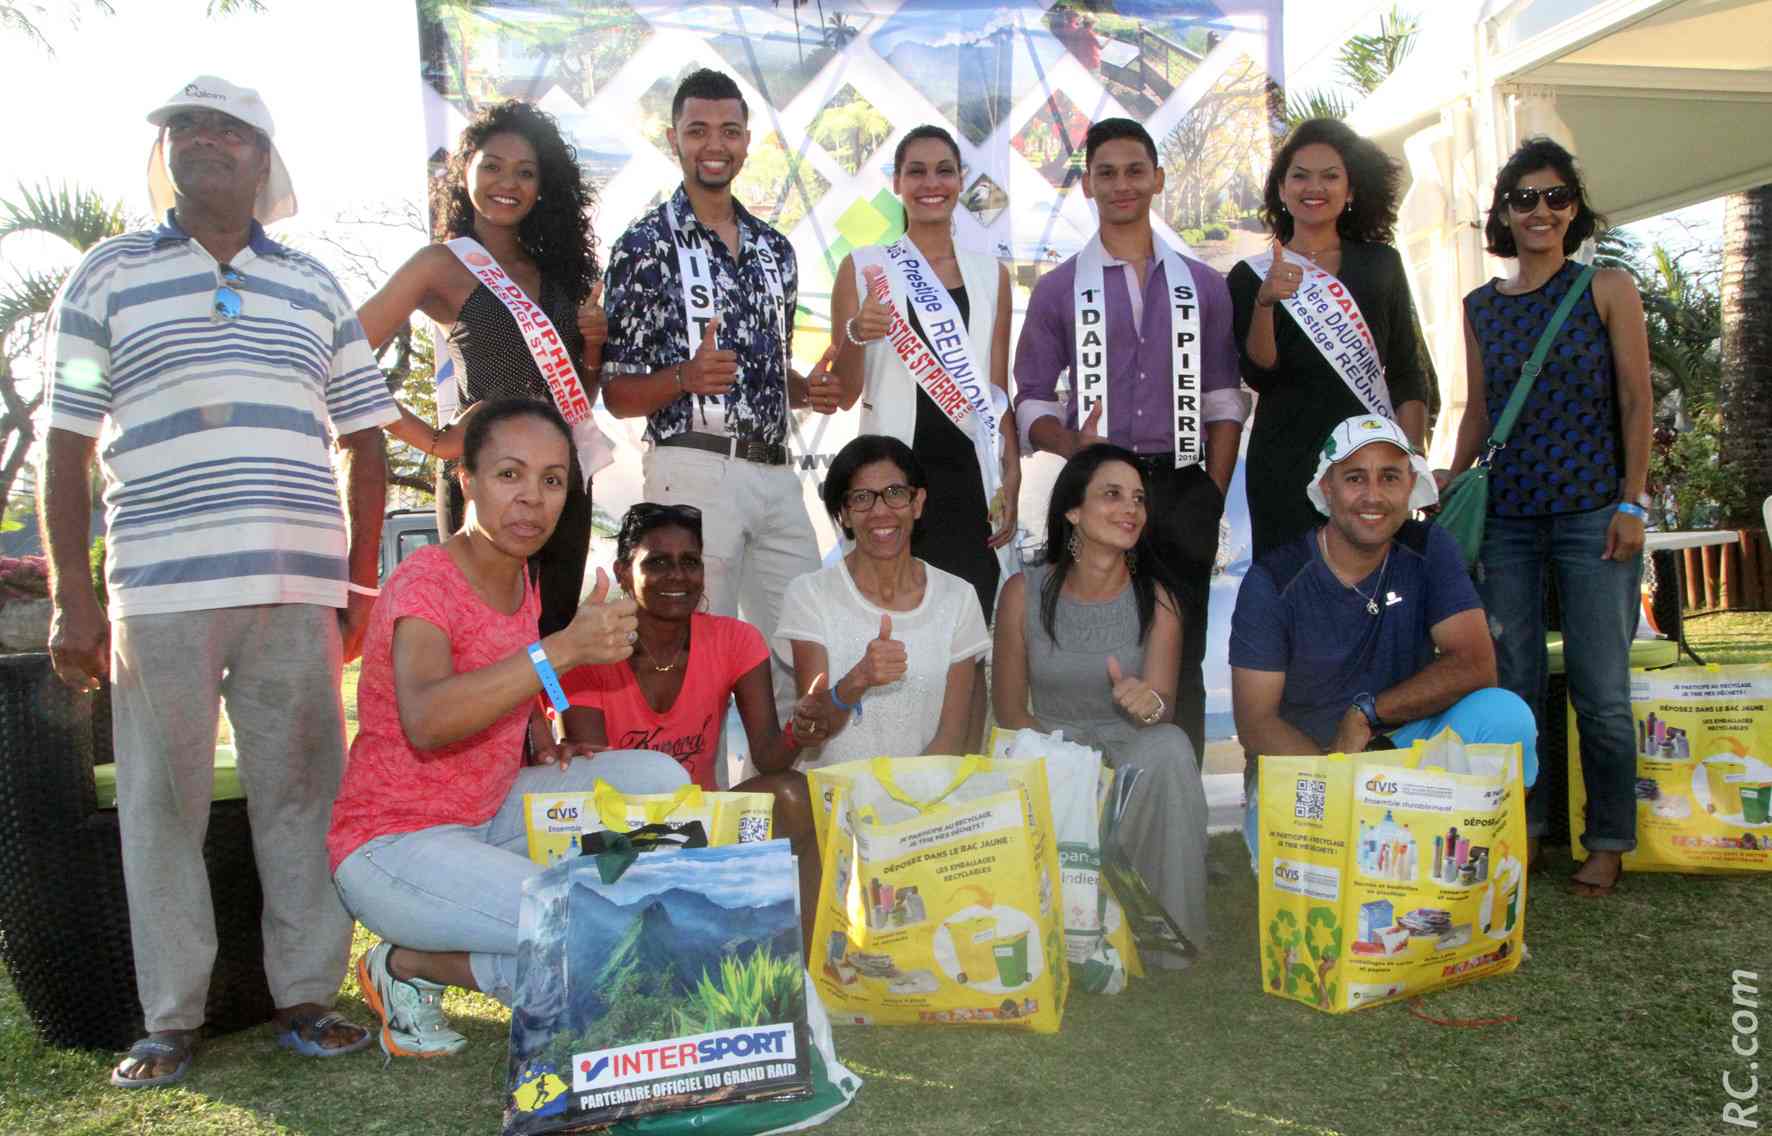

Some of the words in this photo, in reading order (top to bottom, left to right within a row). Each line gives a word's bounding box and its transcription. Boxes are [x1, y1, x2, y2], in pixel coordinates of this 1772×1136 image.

[759, 249, 778, 284] ST
[1174, 286, 1195, 320] ST
[477, 269, 534, 334] PRESTIGE
[530, 337, 549, 360] ST
[541, 362, 576, 426] PIERRE
[488, 268, 506, 281] 2
[507, 285, 589, 415] DAUPHINE
[897, 259, 943, 312] Prestige
[930, 319, 989, 411] REUNION
[1289, 291, 1334, 351] Prestige
[1335, 352, 1393, 420] REUNIO
[1303, 283, 1329, 313] 1ère
[1325, 312, 1381, 384] DAUPHINE
[909, 352, 936, 378] ST
[921, 367, 969, 418] PIERRE
[1177, 332, 1197, 452] PIERRE
[1178, 454, 1199, 462] 2016
[1659, 704, 1693, 712] DÉPOSEZ
[1695, 705, 1714, 713] DANS
[1365, 780, 1398, 794] CIVIS
[546, 807, 578, 820] CIVIS
[883, 855, 922, 874] DÉPOSEZ
[924, 850, 948, 861] DANS
[948, 846, 959, 856] LE
[960, 843, 978, 854] BAC
[979, 836, 1008, 849] JAUNE
[612, 1029, 788, 1078] INTERSPORT
[580, 1084, 651, 1110] PARTENAIRE
[652, 1078, 703, 1096] OFFICIEL
[704, 1074, 723, 1089] DU
[723, 1067, 766, 1086] GRAND
[767, 1062, 797, 1079] RAID
